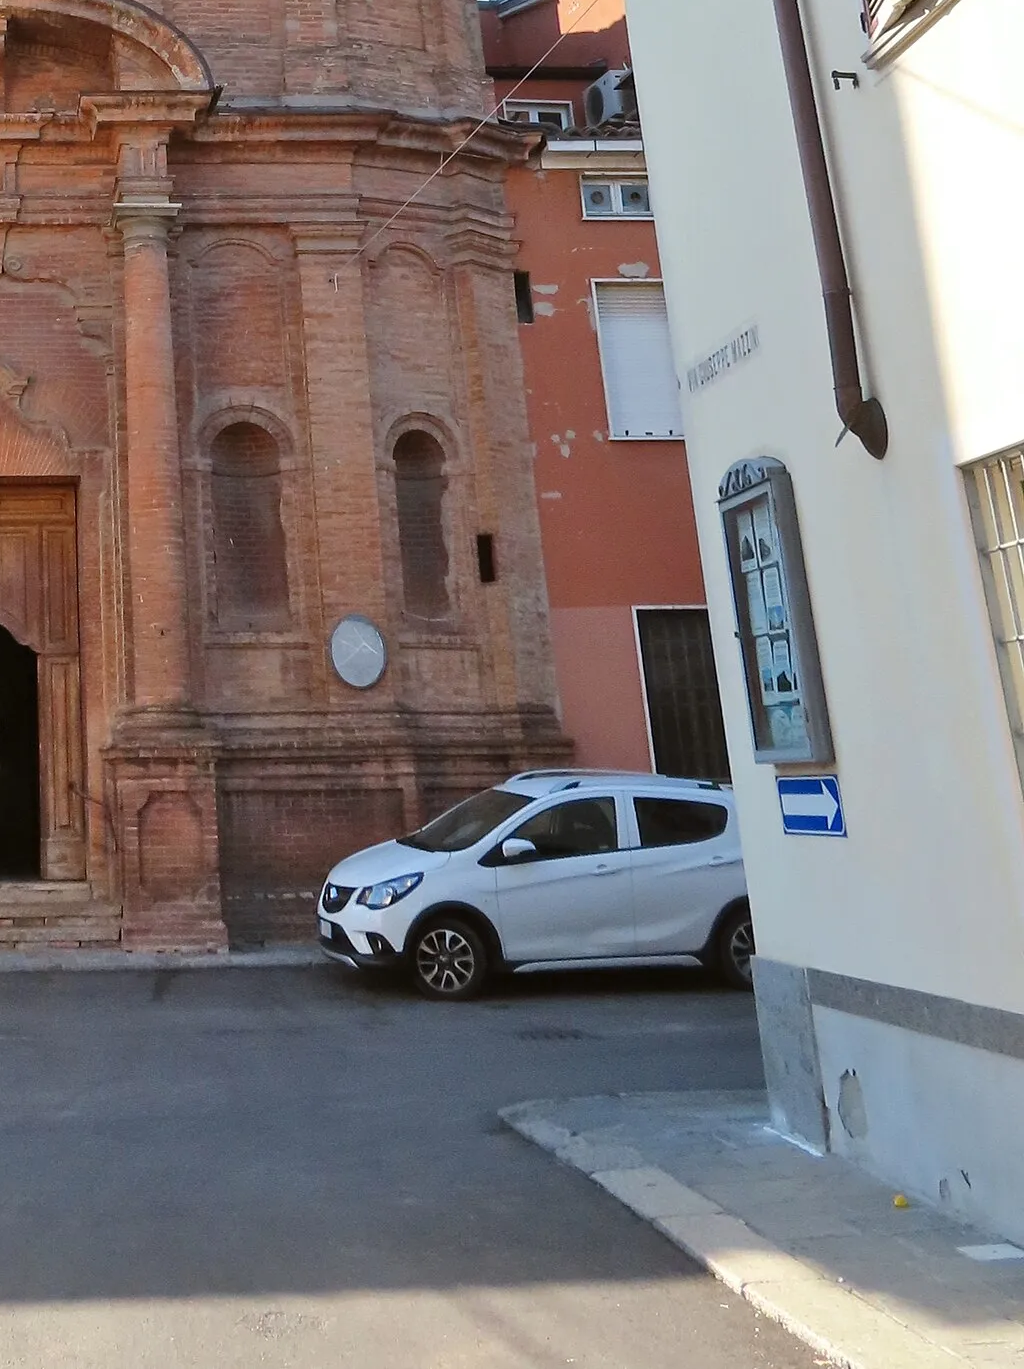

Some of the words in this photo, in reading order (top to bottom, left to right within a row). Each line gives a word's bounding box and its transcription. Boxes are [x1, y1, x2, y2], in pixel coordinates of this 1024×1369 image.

[687, 368, 699, 392] VIA
[698, 344, 731, 386] GIUSEPPE
[731, 324, 760, 363] MAZZINI
